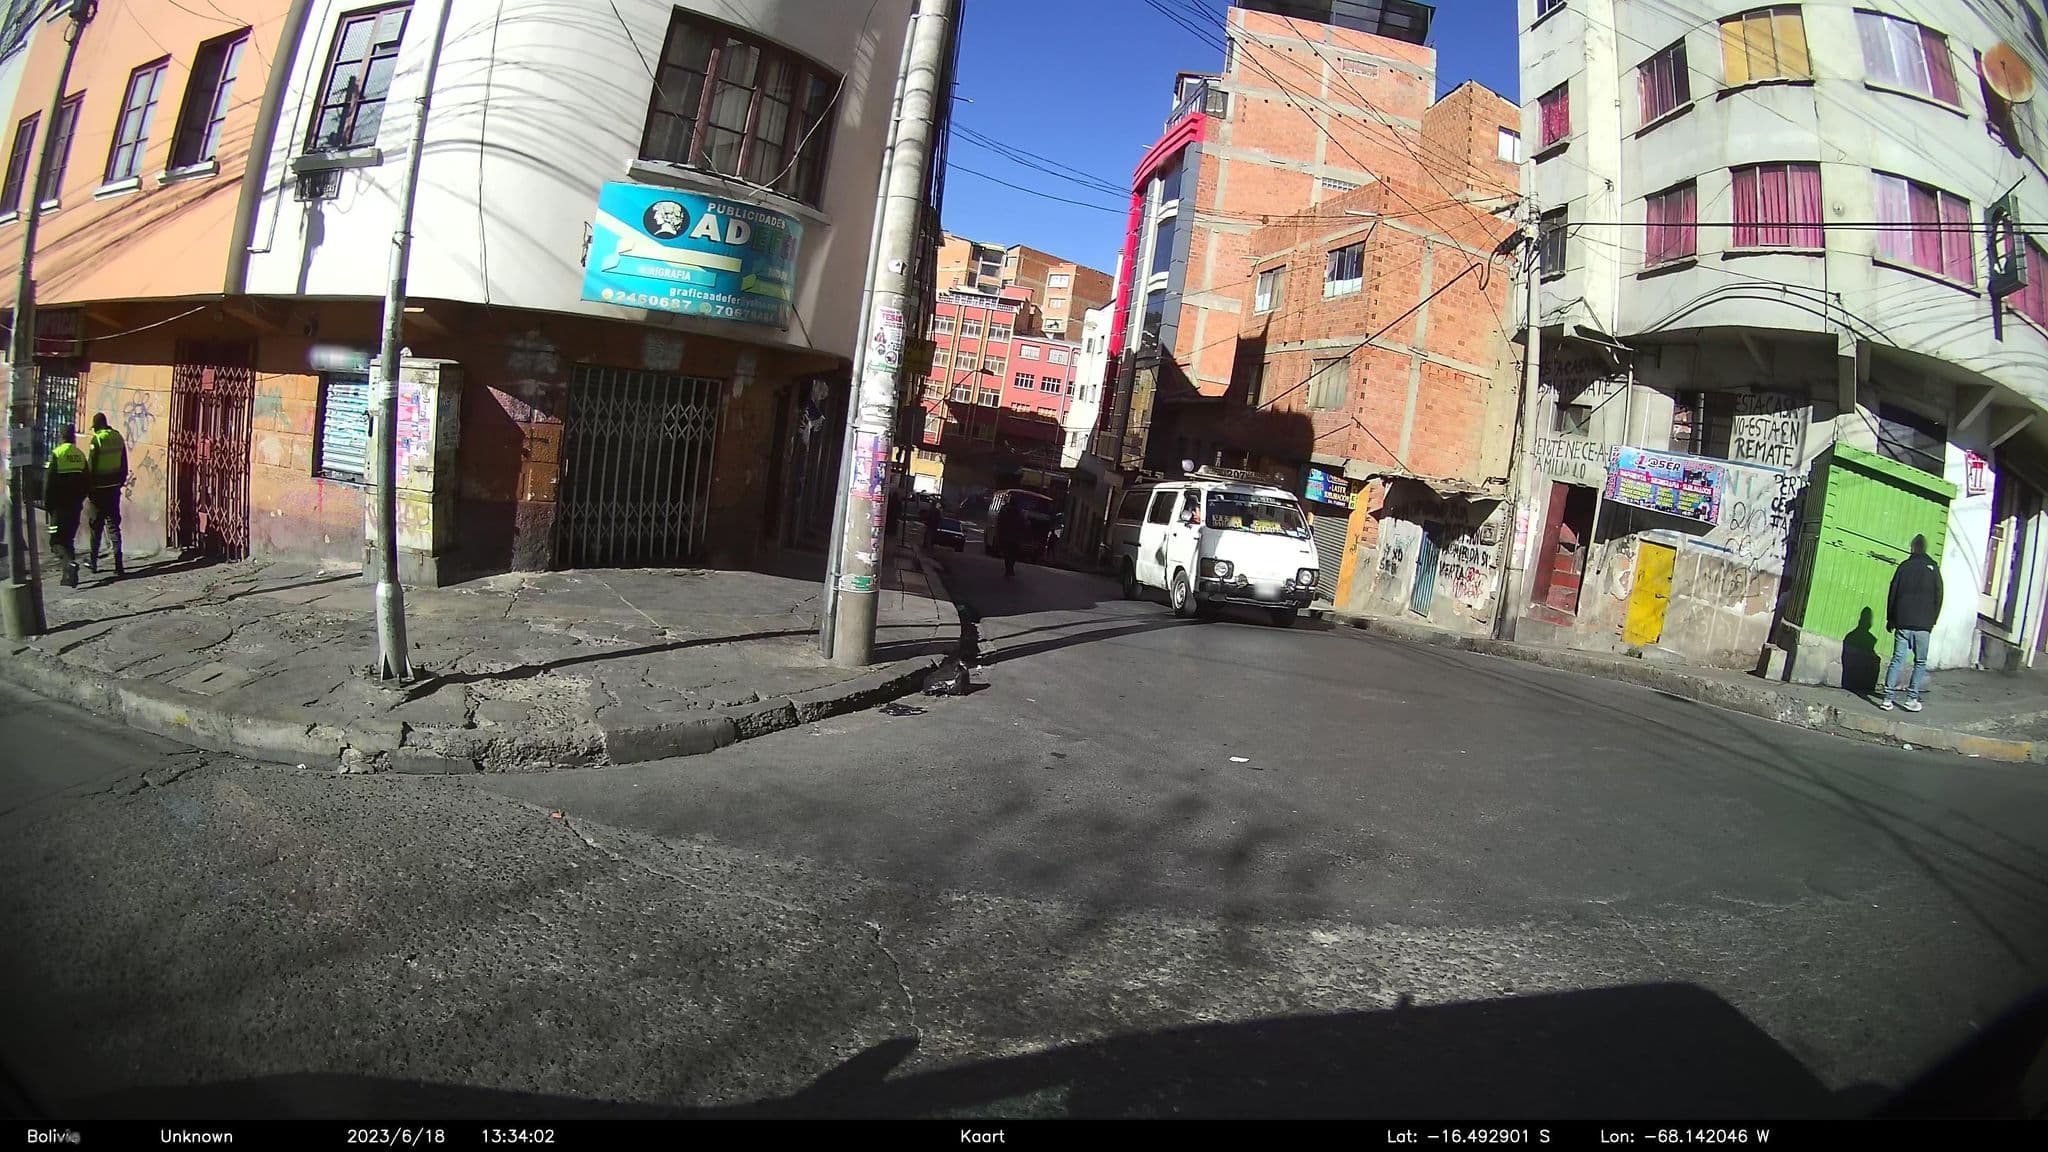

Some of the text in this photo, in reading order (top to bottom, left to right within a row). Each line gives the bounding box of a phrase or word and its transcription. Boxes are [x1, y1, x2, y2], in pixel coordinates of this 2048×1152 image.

[707, 202, 787, 229] PUBLICIDADES
[1735, 437, 1795, 467] REMATE
[1227, 469, 1246, 479] 207
